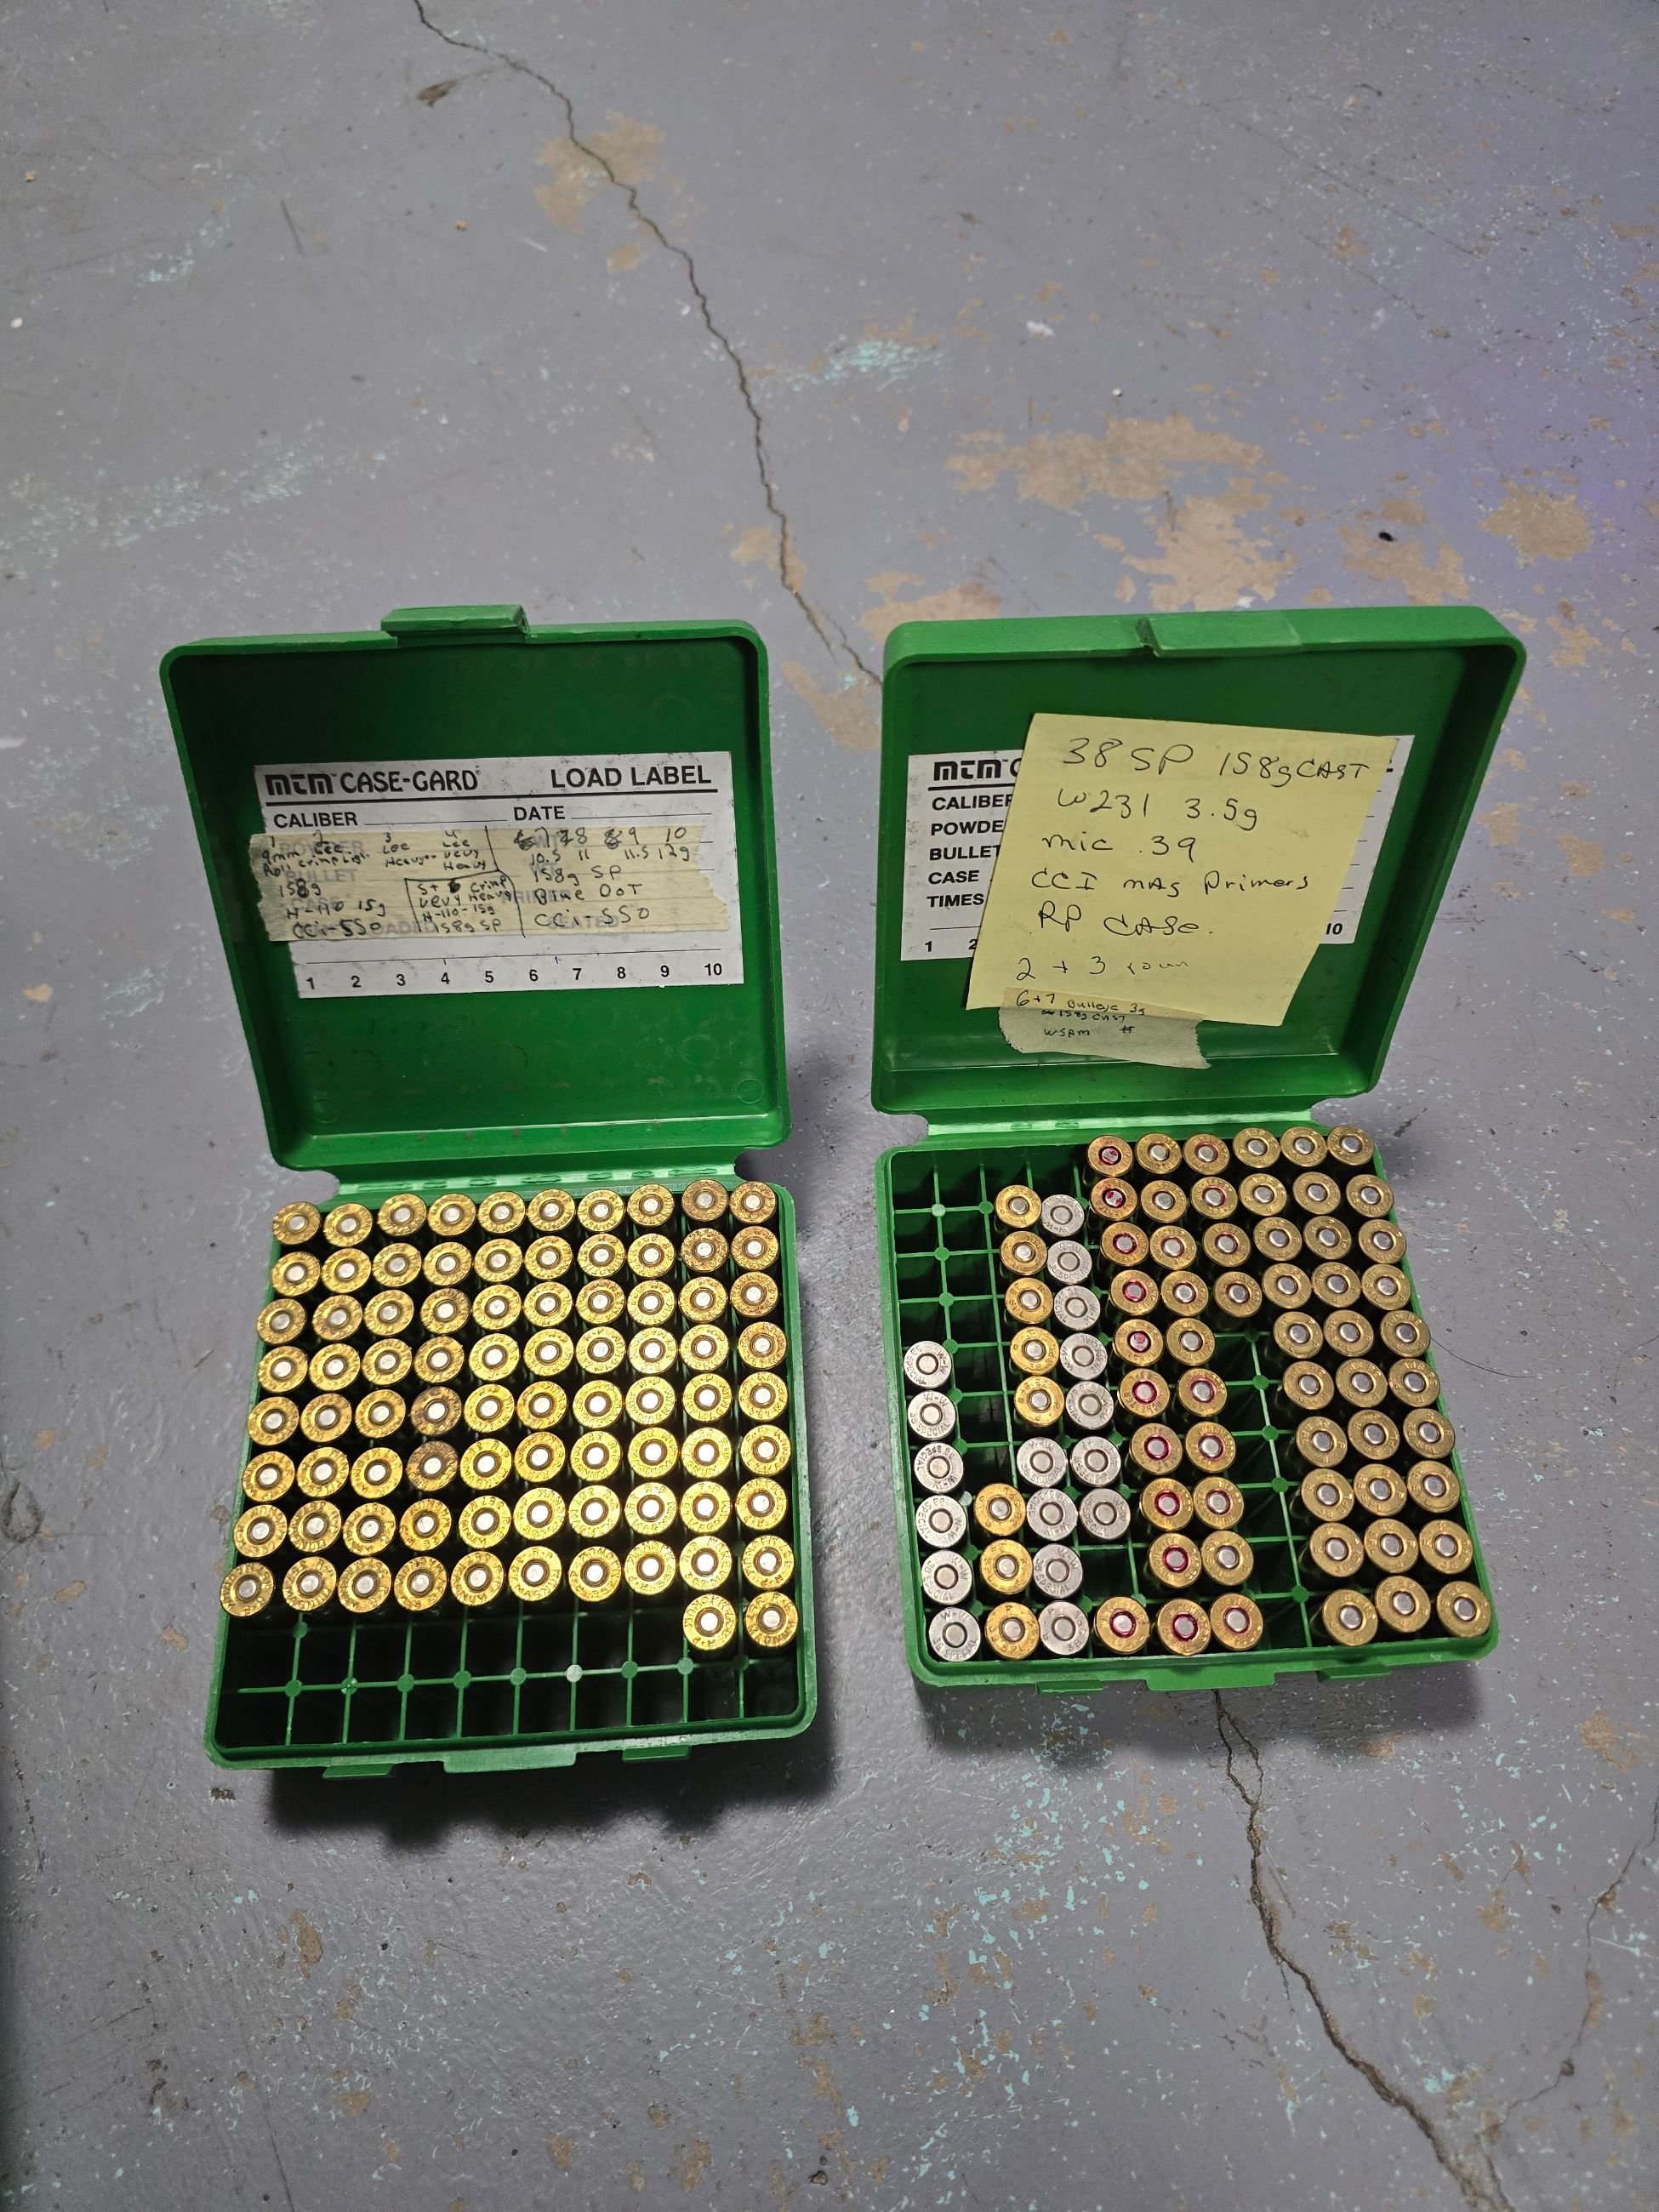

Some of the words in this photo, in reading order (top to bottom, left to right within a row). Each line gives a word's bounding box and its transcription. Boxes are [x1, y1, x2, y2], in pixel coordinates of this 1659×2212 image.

[1063, 738, 1123, 767] 38
[1132, 744, 1194, 775] SP
[340, 770, 479, 793] CASE-GARD
[550, 767, 622, 789] LOAD
[631, 765, 712, 786] LABEL
[273, 812, 358, 829] CALIBER
[513, 806, 566, 821] DATE
[1186, 798, 1257, 831] 3.5g
[666, 827, 687, 842] 10
[931, 819, 1004, 836] POWDE
[532, 850, 562, 865] 10.5
[929, 844, 1001, 861] BULLET
[534, 868, 580, 887] 158g
[591, 864, 621, 881] SP
[928, 870, 980, 885] CASE
[1031, 867, 1097, 890] CCI
[279, 878, 321, 898] 158g
[926, 893, 984, 908] TIMES
[1038, 900, 1081, 932] RP
[1325, 923, 1343, 935] 10
[925, 940, 932, 952] 1
[968, 938, 978, 951] 2
[306, 977, 316, 990] 1
[351, 975, 362, 989] 2
[396, 973, 407, 987] 3
[441, 972, 451, 985] 4
[485, 970, 494, 983] 5
[529, 969, 539, 983] 6
[573, 967, 582, 981] 7
[617, 966, 627, 980] 8
[660, 965, 670, 978] 9
[704, 963, 723, 977] 10
[1017, 957, 1036, 980] 2
[1089, 955, 1105, 974] 3
